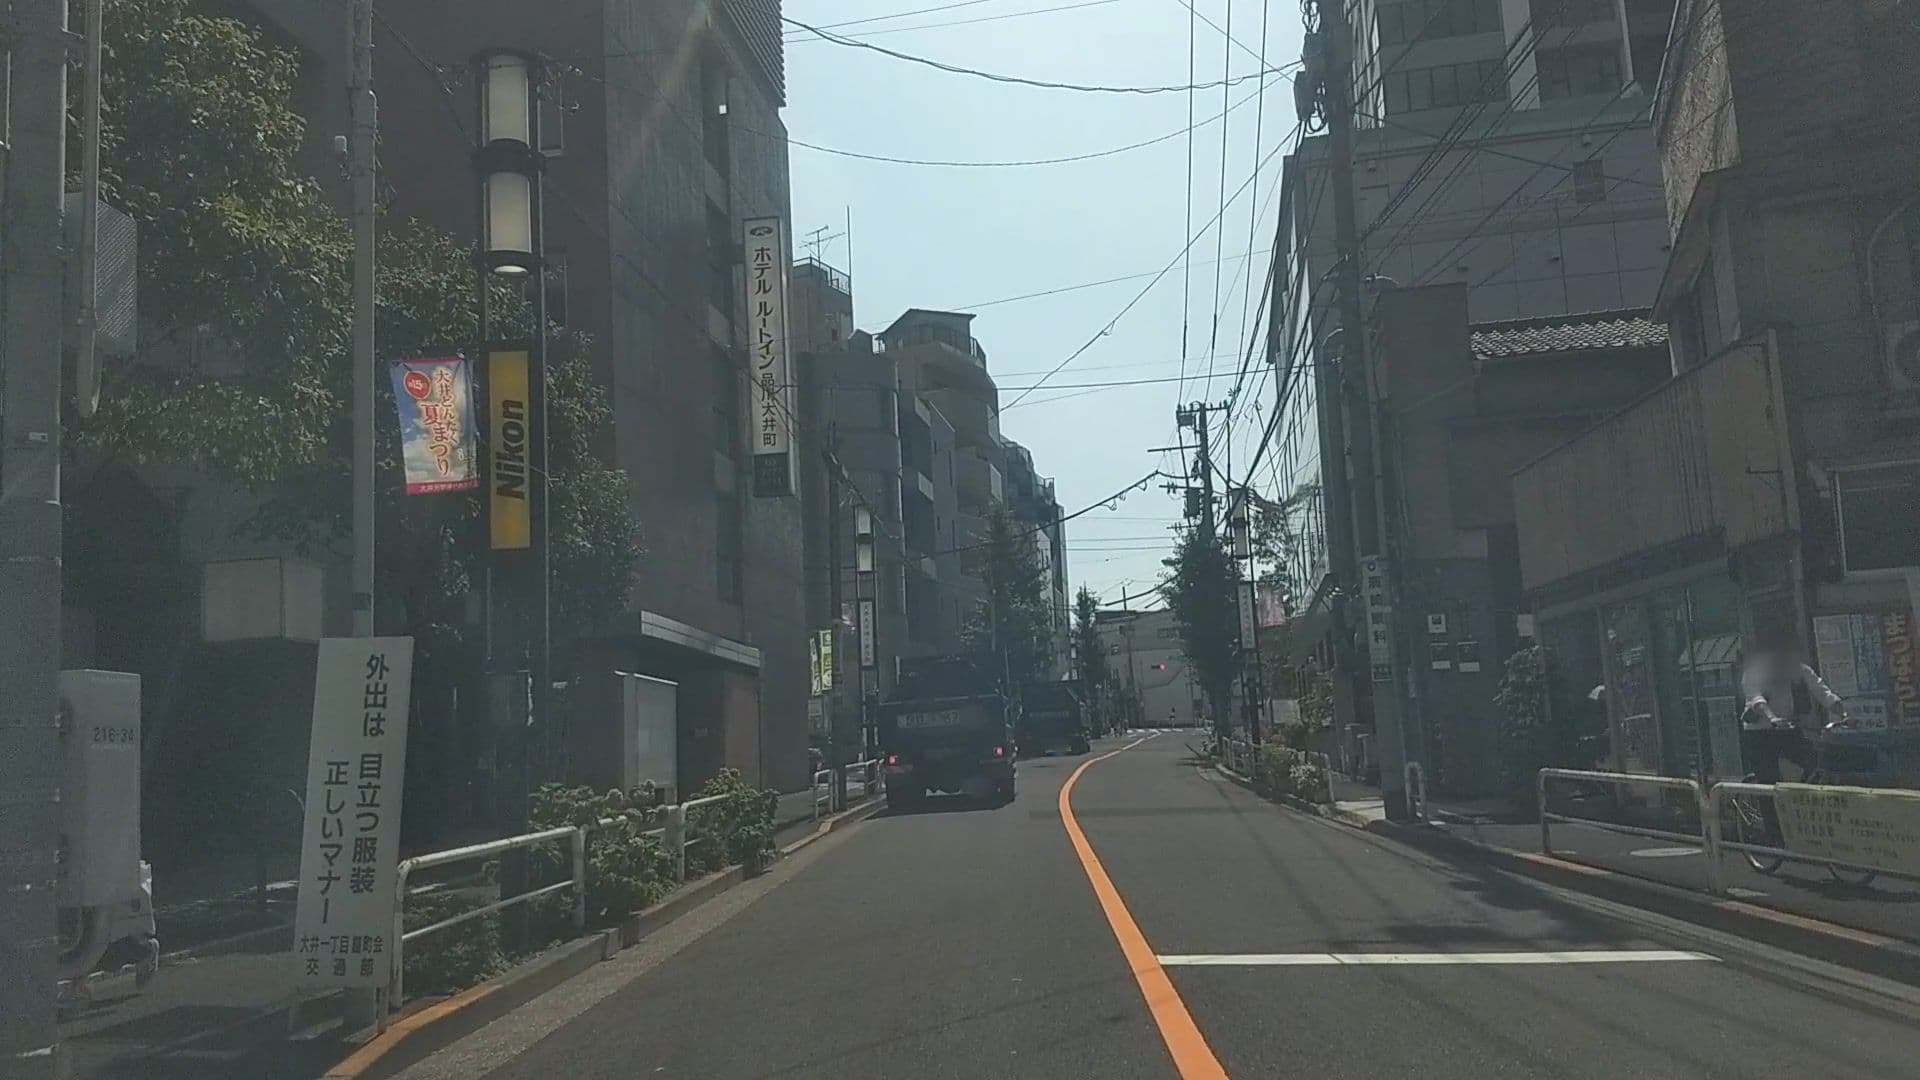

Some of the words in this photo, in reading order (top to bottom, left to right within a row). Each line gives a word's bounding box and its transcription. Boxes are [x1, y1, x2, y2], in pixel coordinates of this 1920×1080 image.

[753, 246, 773, 295] ホテル
[756, 300, 776, 371] ルートイン
[420, 402, 451, 477] 夏まつり
[496, 399, 526, 501] Nikon
[363, 654, 391, 737] 外出は
[316, 760, 350, 925] 正しいマナー
[349, 752, 383, 894] 目立つ服装
[299, 935, 384, 954] 大井一丁目町会
